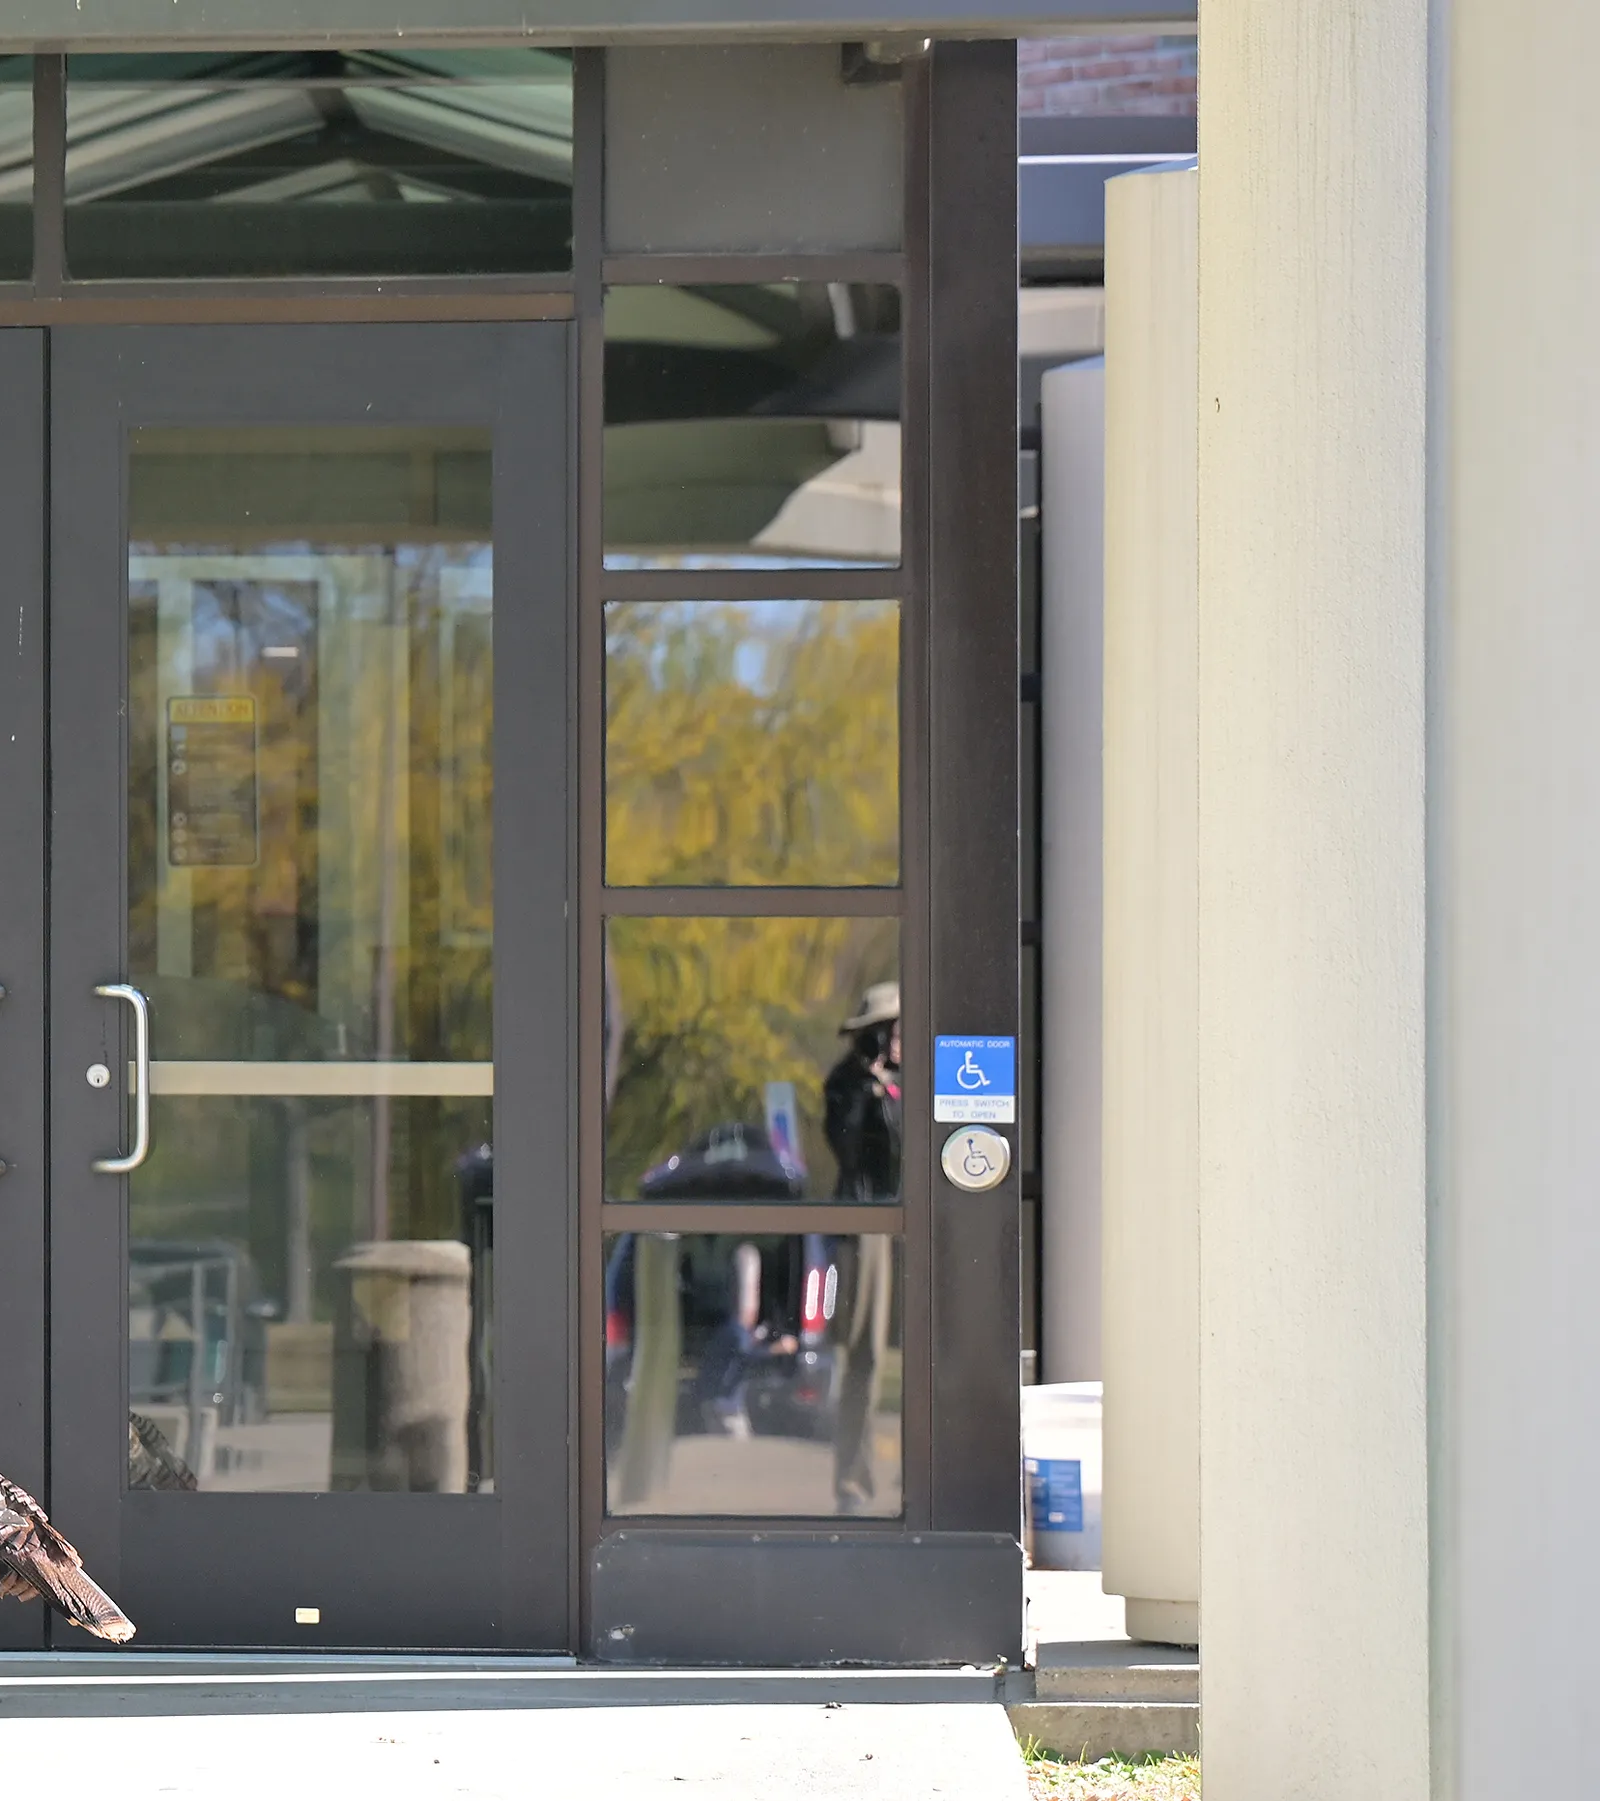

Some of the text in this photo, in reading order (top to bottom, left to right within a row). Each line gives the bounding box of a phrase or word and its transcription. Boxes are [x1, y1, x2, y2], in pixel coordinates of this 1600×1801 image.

[939, 1040, 1011, 1048] AUTOMATIC DOOR
[940, 1099, 1010, 1107] PRESS SWITCH
[952, 1110, 996, 1119] TO OPEN
